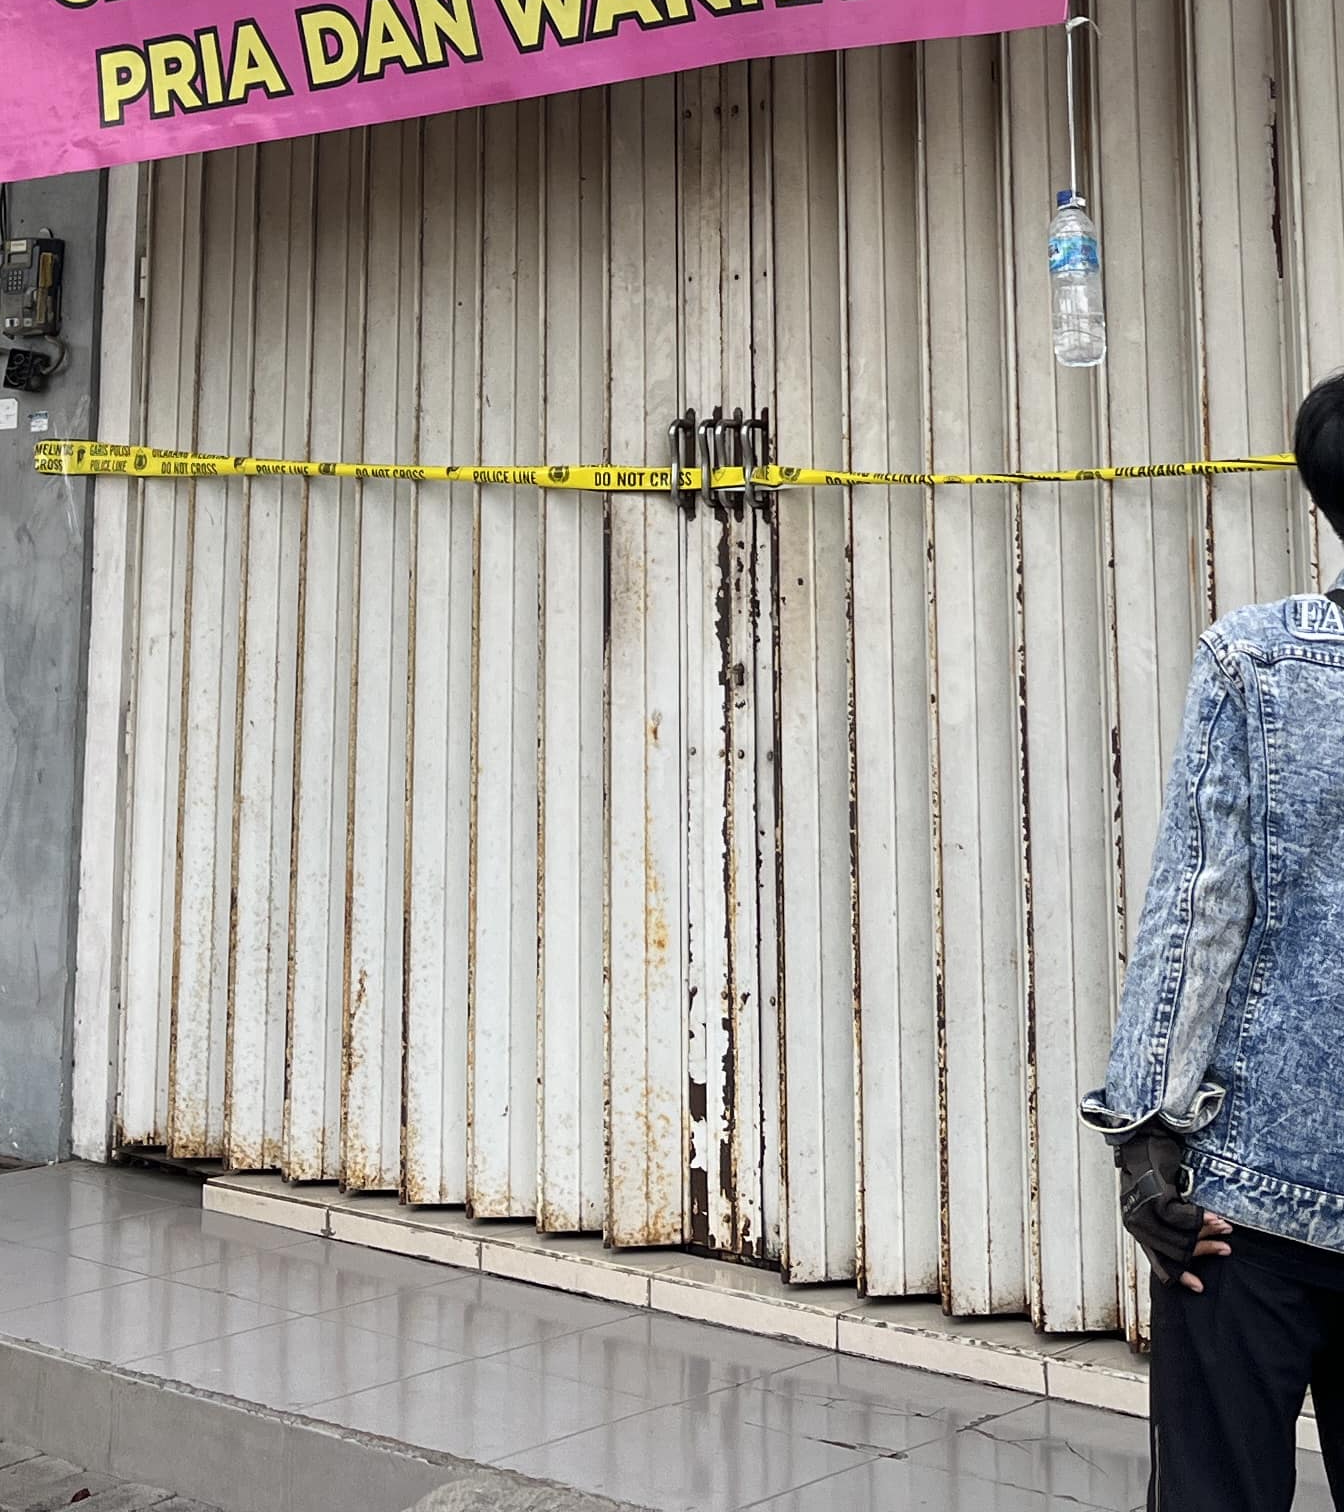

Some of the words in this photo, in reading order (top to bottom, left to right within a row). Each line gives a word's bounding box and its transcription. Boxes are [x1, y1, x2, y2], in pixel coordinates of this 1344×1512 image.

[98, 33, 294, 129] PRIA
[161, 462, 171, 475] DO
[174, 462, 188, 475] NOT
[190, 462, 218, 475] CROSS
[473, 470, 509, 484] POLICE
[512, 471, 538, 485] LINE
[594, 471, 611, 487] DO
[617, 471, 645, 487] NOT
[650, 471, 692, 487] CRSS
